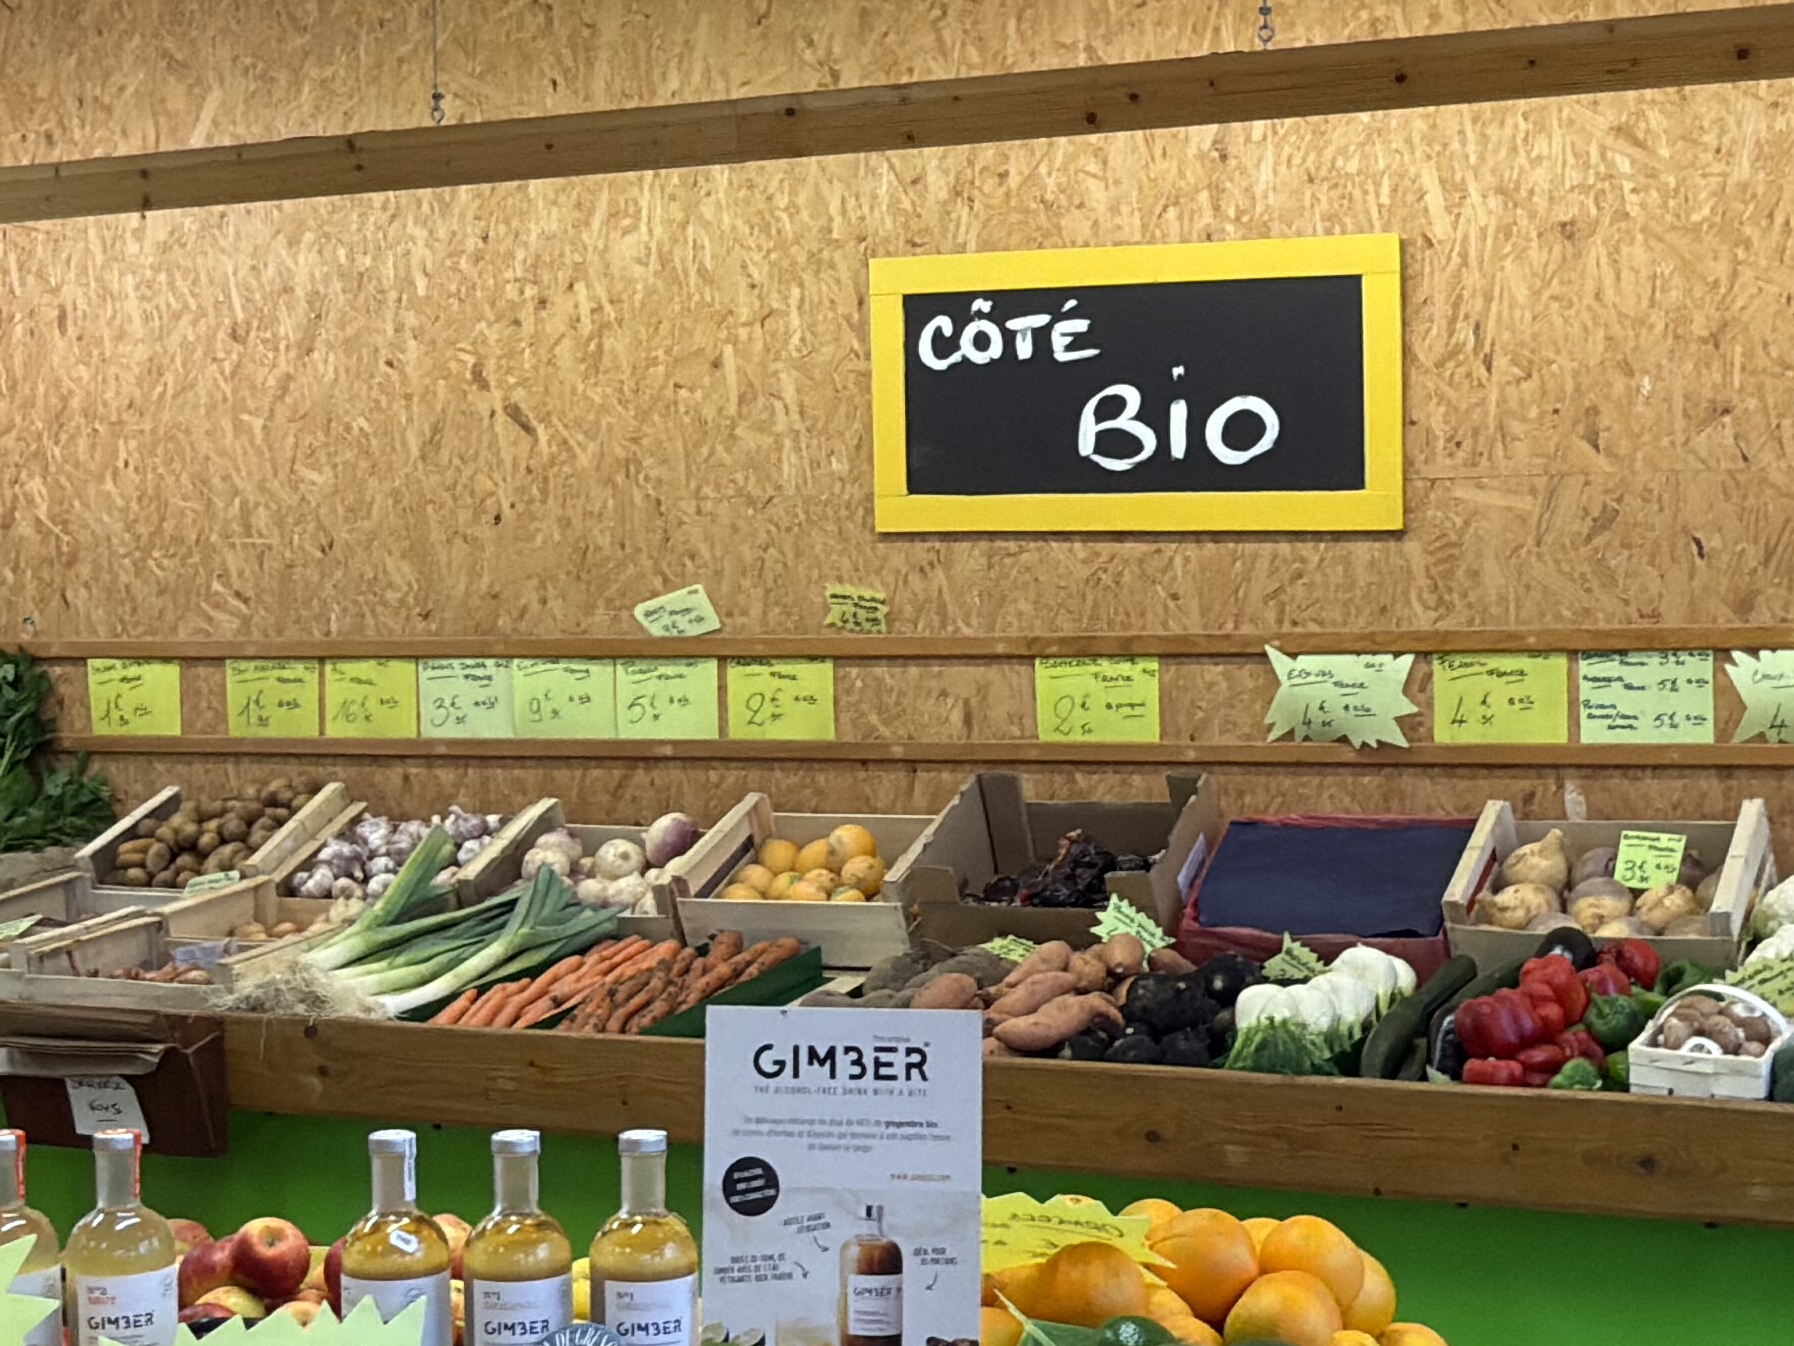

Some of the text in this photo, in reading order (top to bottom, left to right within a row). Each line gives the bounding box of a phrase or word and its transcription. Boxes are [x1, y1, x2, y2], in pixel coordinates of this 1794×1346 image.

[918, 298, 1102, 372] CÔTÉ
[430, 697, 451, 728] 3
[627, 694, 648, 724] 5
[745, 692, 766, 727] 2
[1054, 694, 1075, 736] 2
[1302, 703, 1313, 730] 4
[1450, 695, 1468, 728] 4
[1768, 702, 1789, 737] 4
[1622, 859, 1638, 882] 3
[752, 1042, 930, 1083] GIMBER
[86, 1311, 155, 1331] GIMBER
[483, 1318, 551, 1336] GIMBER
[615, 1318, 683, 1337] GIMBER
